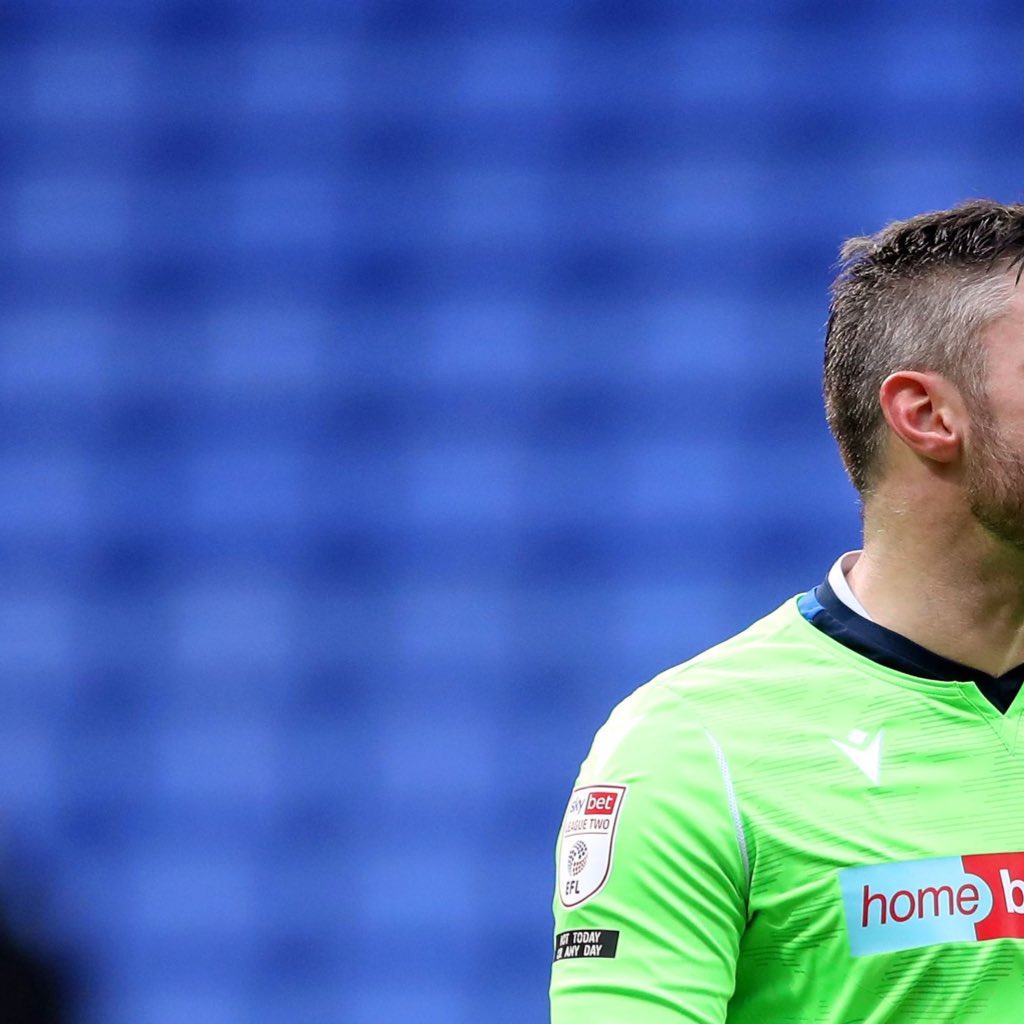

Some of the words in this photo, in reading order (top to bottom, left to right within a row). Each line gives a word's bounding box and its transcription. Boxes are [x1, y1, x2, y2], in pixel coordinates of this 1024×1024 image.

[570, 797, 586, 815] sky
[587, 795, 613, 810] bet
[590, 818, 610, 830] TWO
[566, 880, 580, 896] EFL
[861, 883, 979, 928] home
[573, 931, 601, 944] TODAY
[564, 945, 580, 958] ANY
[583, 944, 603, 957] DAY
